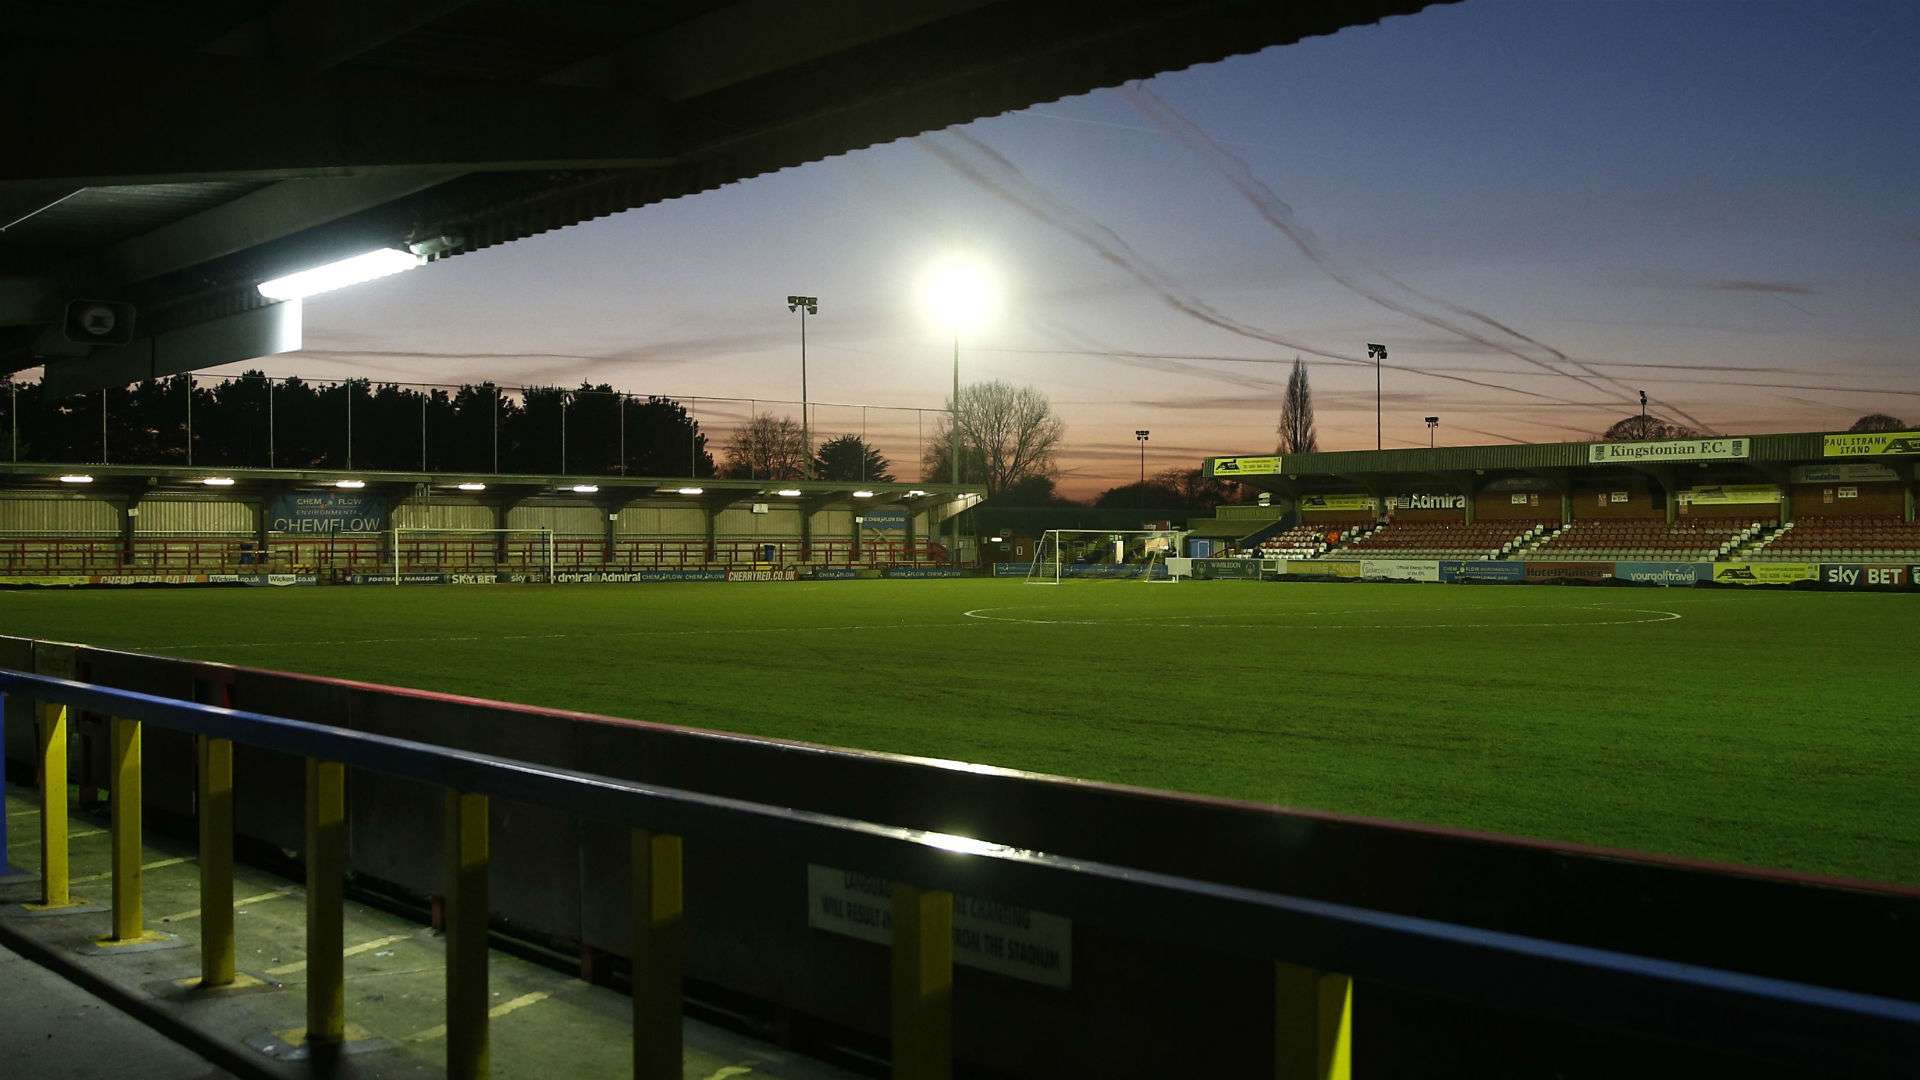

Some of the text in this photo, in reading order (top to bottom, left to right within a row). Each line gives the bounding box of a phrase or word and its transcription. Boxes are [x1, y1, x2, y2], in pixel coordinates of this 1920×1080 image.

[1824, 437, 1888, 447] PAUL STRANK
[1610, 442, 1727, 458] Kingstonian F.C.
[1840, 446, 1870, 454] STAND
[1410, 493, 1466, 509] Admira
[274, 518, 380, 532] CHEMFLOW
[553, 572, 592, 583] dmiral
[601, 572, 640, 583] Admiral
[728, 571, 796, 581] CHERRYRED.CO.UK
[1828, 566, 1859, 586] sky
[1867, 568, 1902, 584] BET
[1007, 941, 1060, 968] STADIUM
